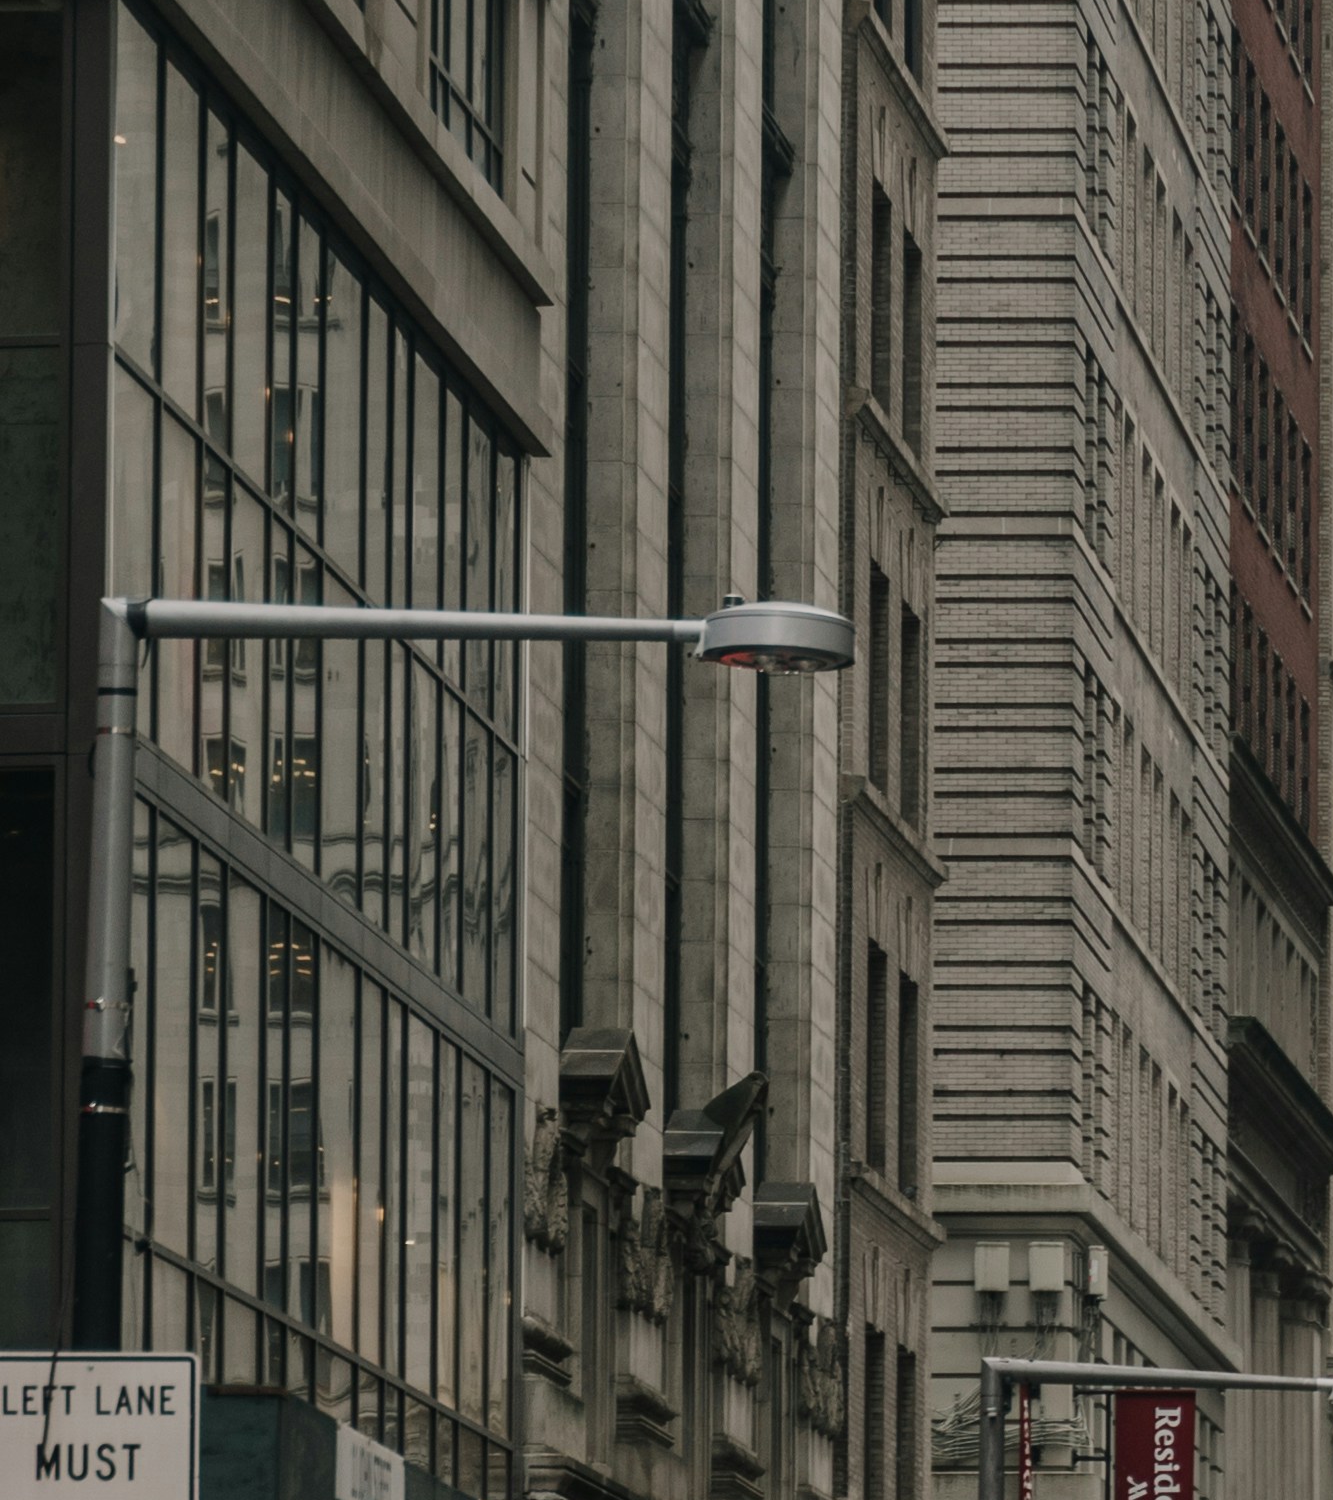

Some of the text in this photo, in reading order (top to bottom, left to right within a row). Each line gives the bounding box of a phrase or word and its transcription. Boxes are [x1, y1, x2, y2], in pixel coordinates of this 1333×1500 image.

[3, 1385, 176, 1416] LEFT LANE
[36, 1443, 142, 1481] MUST
